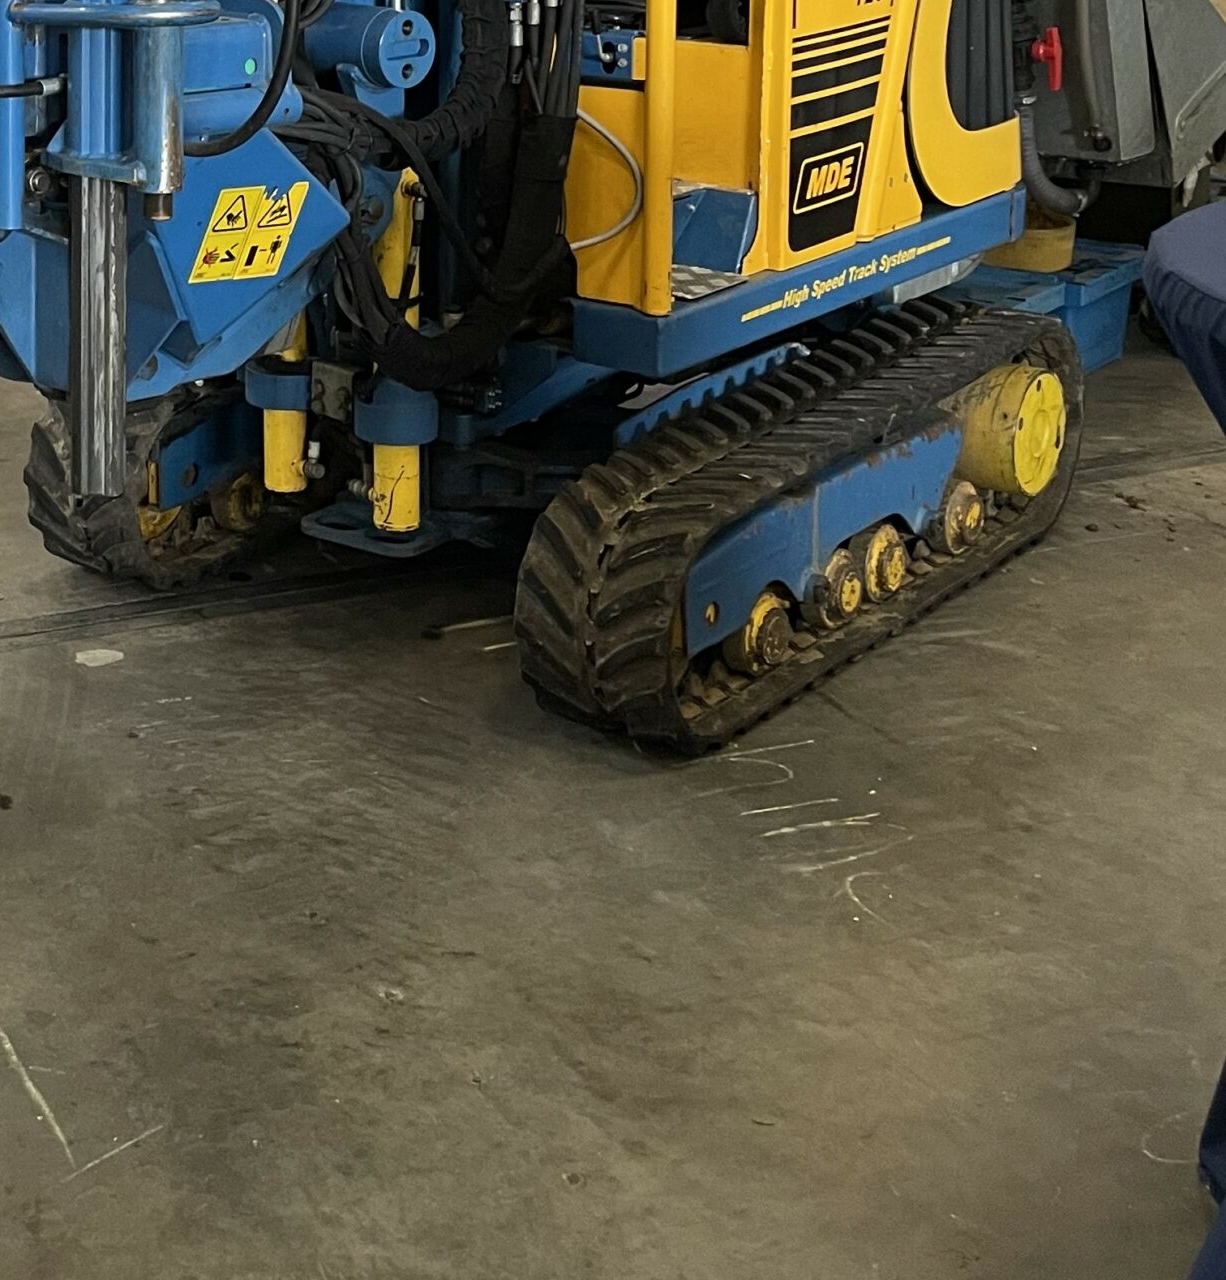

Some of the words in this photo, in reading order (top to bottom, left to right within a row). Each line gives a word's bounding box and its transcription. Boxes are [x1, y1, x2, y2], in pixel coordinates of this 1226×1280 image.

[805, 156, 855, 200] MDE
[783, 285, 810, 308] High
[811, 271, 846, 299] Speed
[848, 260, 878, 284] Track
[879, 248, 917, 274] System
